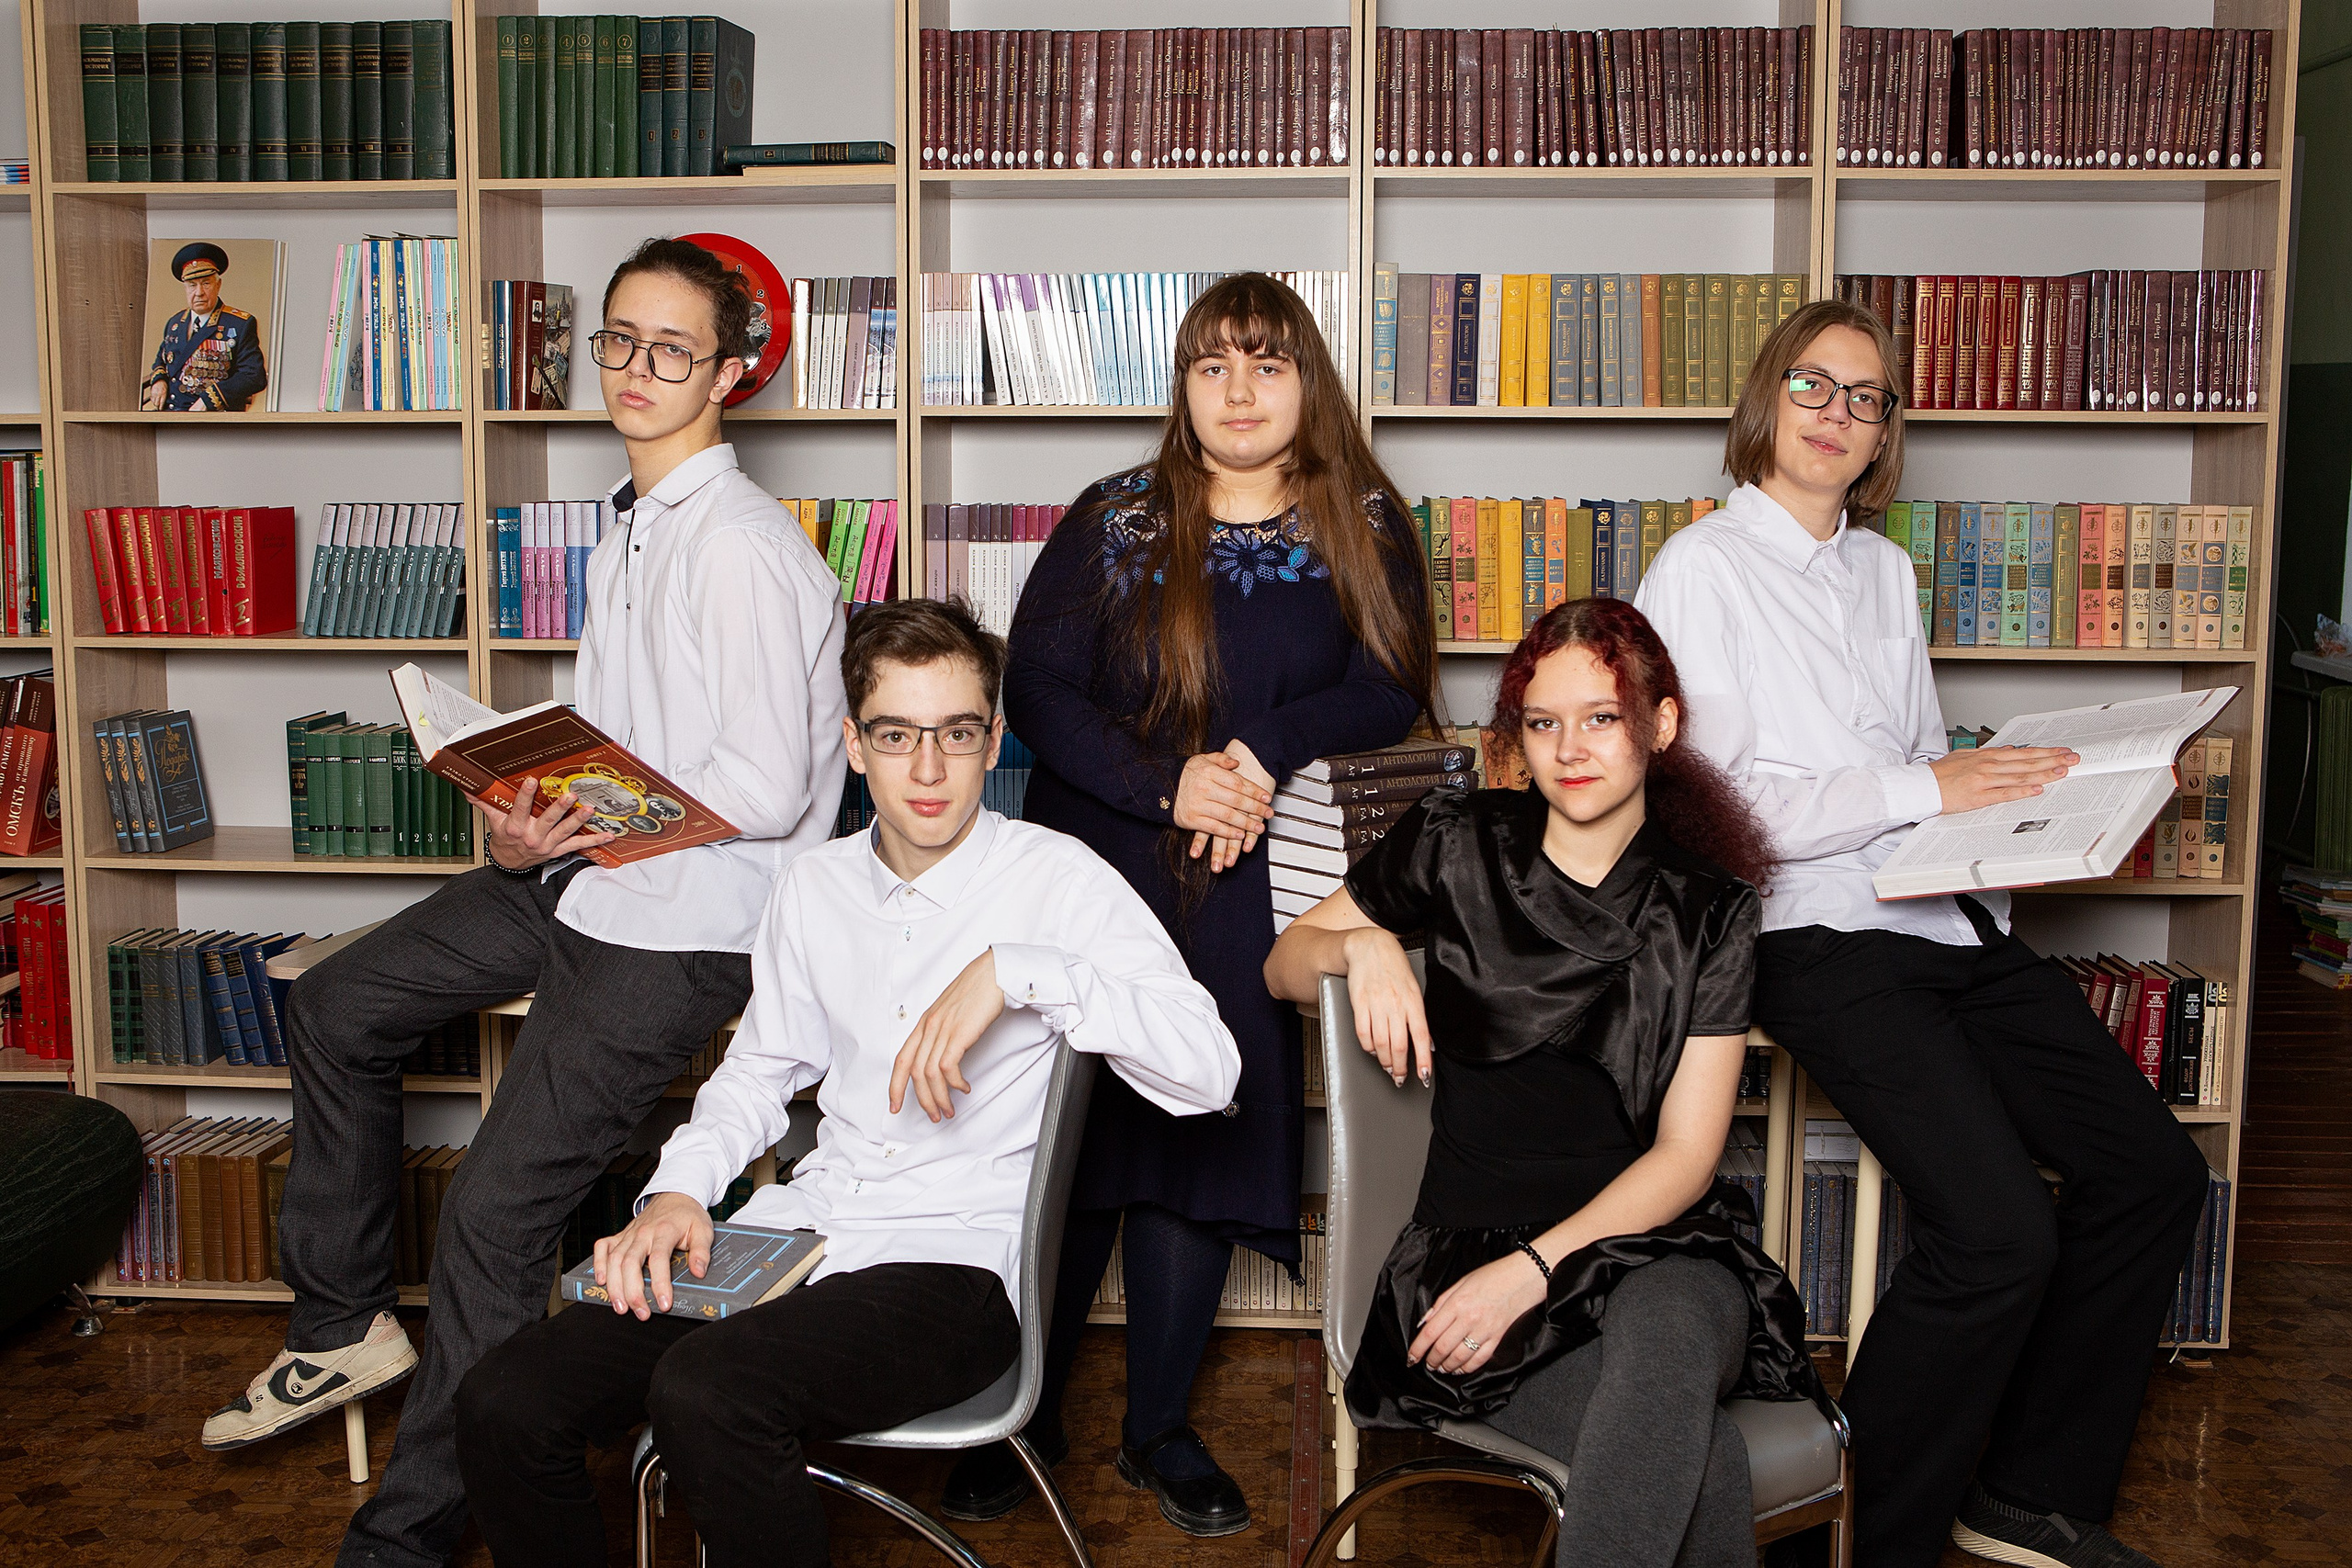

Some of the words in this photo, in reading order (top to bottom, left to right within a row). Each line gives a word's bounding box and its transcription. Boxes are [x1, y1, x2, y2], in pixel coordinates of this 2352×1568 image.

[736, 265, 742, 274] 1
[756, 289, 765, 299] 2
[761, 322, 767, 331] 3
[211, 519, 223, 580] МАЯКОВСКИЙ
[0, 735, 14, 770] ОМСКА
[17, 734, 28, 771] прошлого
[22, 735, 36, 776] настоящему
[1383, 752, 1437, 765] АНТОЛОГИЯ
[1361, 764, 1375, 773] 1
[1386, 777, 1440, 789] АНТОЛОГИЯ
[1364, 786, 1379, 796] 1
[6, 785, 26, 837] ОМСКЪ
[1372, 807, 1385, 818] 2
[399, 832, 402, 841] 1
[414, 833, 420, 842] 2
[427, 833, 433, 841] 3
[443, 833, 448, 841] 4
[460, 833, 466, 841] 5
[1372, 829, 1385, 840] 2
